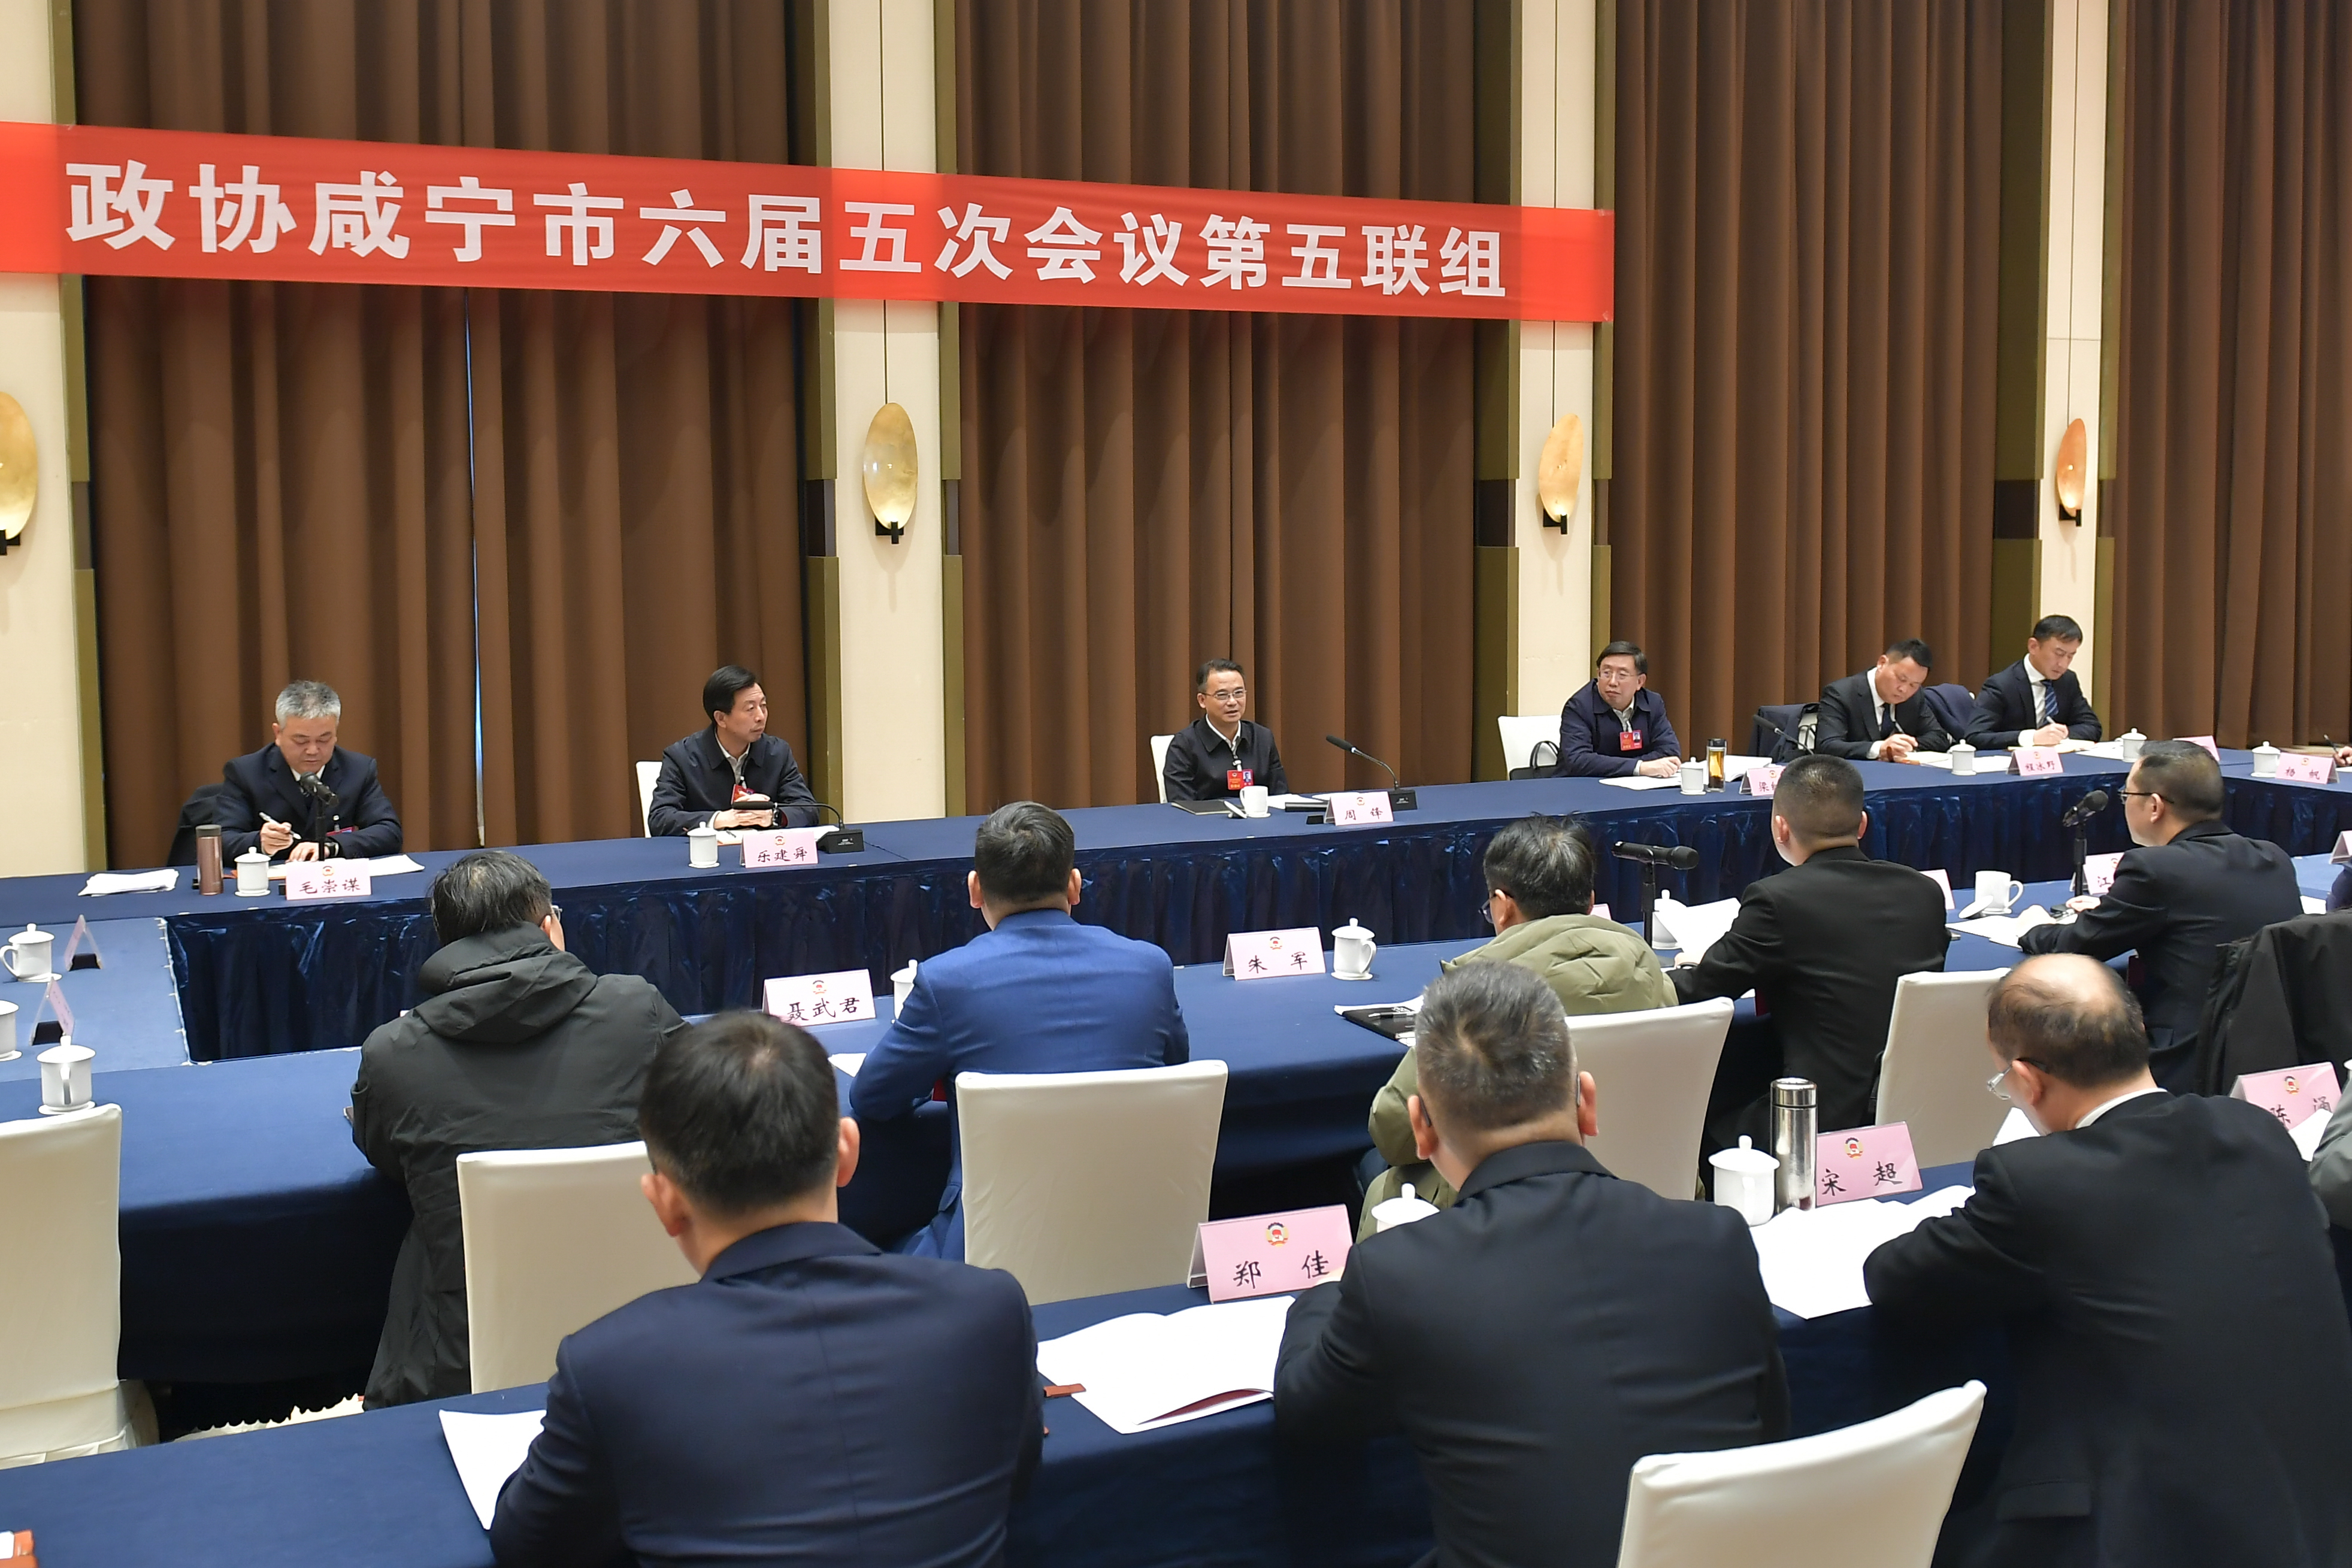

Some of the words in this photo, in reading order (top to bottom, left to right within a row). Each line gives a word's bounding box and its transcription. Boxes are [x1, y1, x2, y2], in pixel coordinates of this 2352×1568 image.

[65, 159, 1506, 298] 政协咸宁市六届五次会议第五联组
[1758, 781, 1776, 792] 梁
[1345, 807, 1383, 821] 周锋
[757, 846, 808, 862] 乐建舜
[299, 877, 361, 894] 毛崇谋
[1248, 951, 1307, 974] 朱军
[786, 997, 860, 1021] 聂武君
[1821, 1161, 1903, 1197] 宋超
[1233, 1250, 1330, 1289] 郑佳
